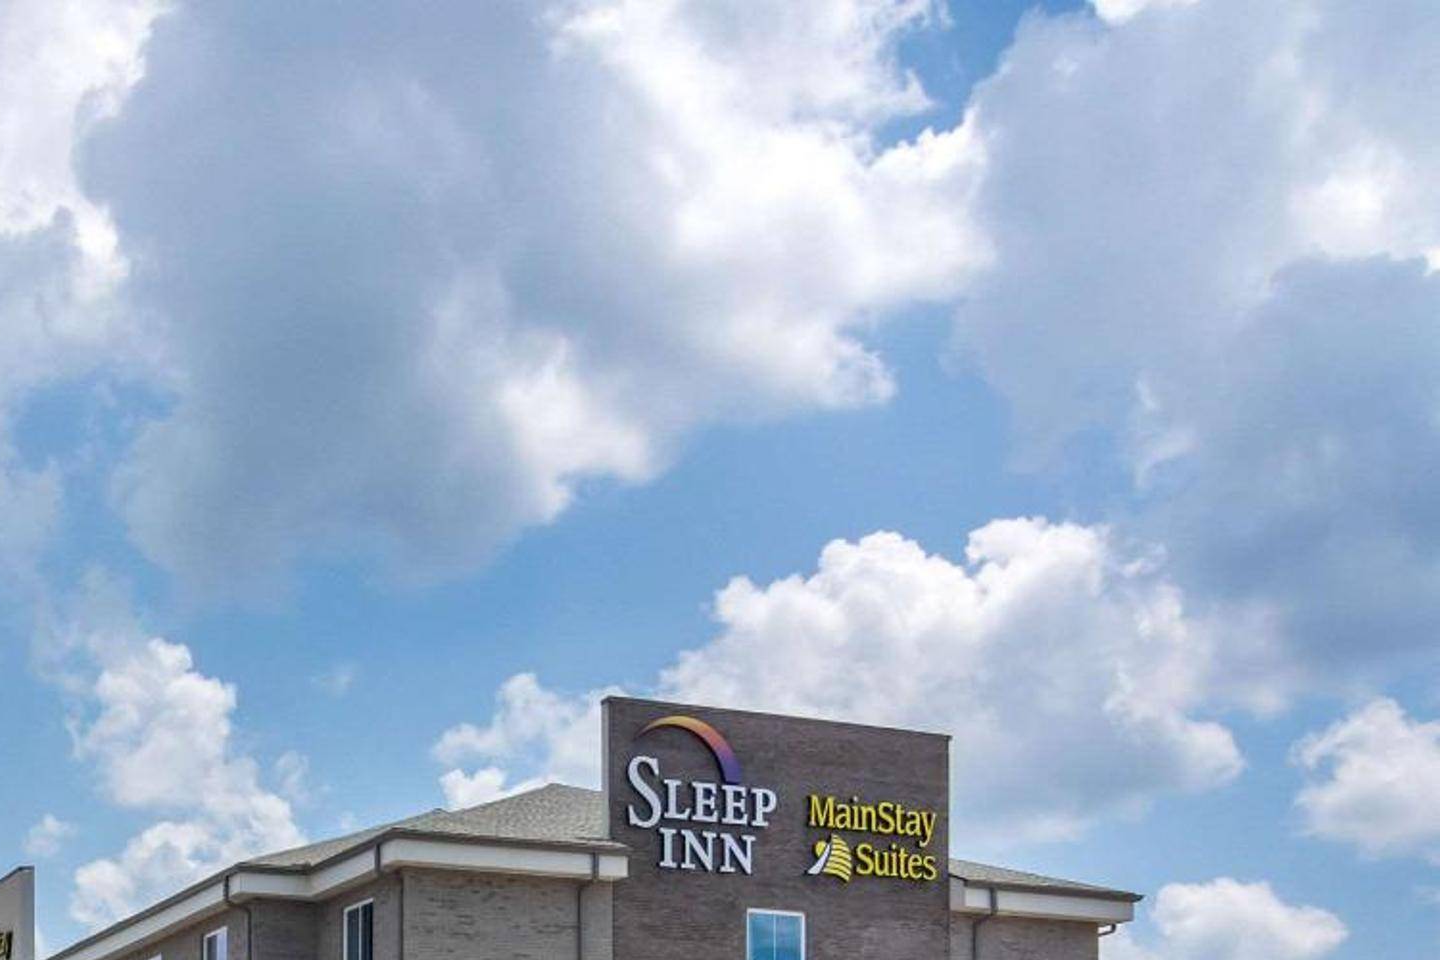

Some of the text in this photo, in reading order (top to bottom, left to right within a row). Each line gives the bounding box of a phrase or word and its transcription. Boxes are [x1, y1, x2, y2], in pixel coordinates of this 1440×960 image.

[626, 755, 778, 828] SLEEP
[809, 794, 937, 847] MainStay
[659, 828, 756, 875] INN
[855, 844, 938, 881] Suites
